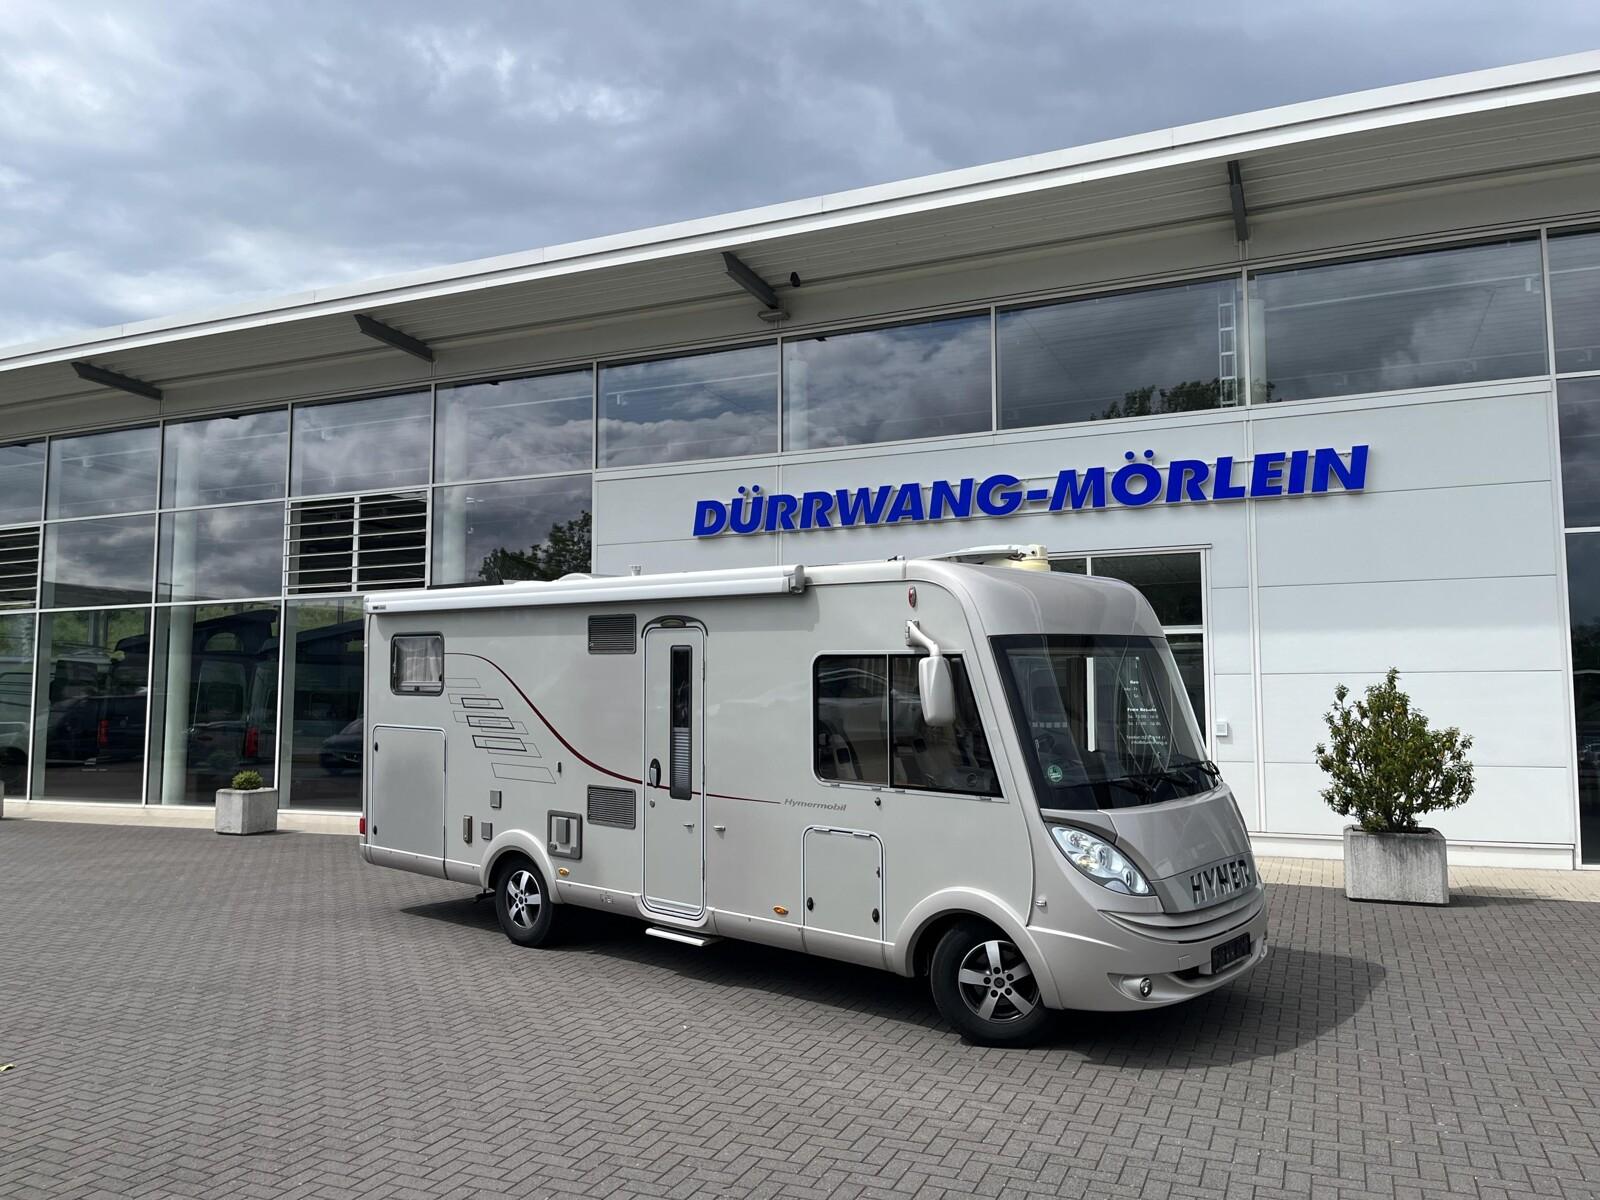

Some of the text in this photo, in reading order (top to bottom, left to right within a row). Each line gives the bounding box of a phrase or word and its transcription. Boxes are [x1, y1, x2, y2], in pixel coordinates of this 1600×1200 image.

[693, 444, 1370, 537] DÜRRWANG-MÖRLEIN
[784, 798, 847, 811] Hymermobil
[1189, 859, 1252, 905] HYMER
